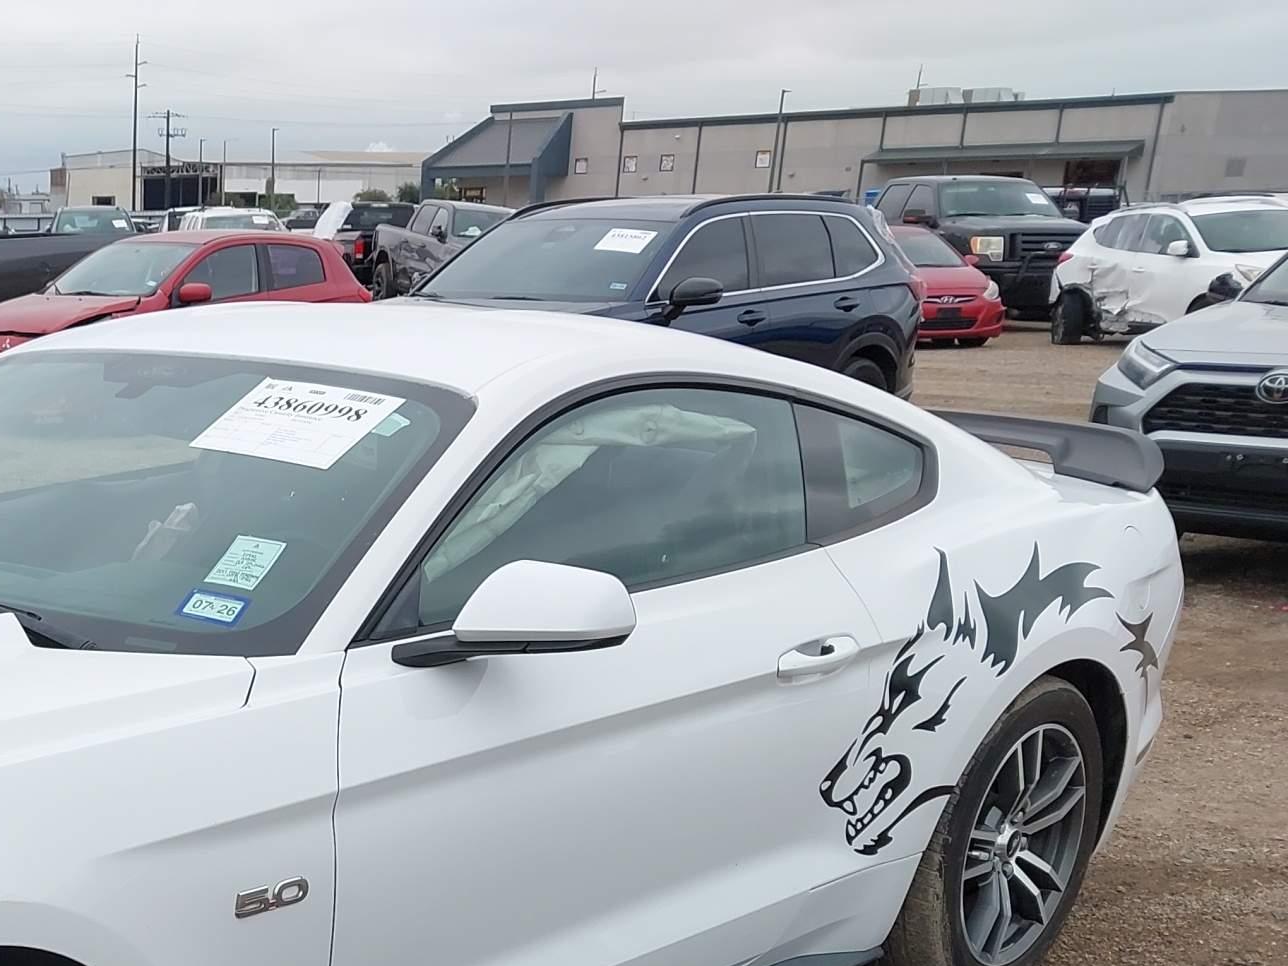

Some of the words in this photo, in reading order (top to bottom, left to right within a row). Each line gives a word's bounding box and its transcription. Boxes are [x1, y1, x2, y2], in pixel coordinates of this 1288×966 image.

[253, 395, 368, 422] 43860998
[192, 599, 213, 610] 07
[217, 604, 238, 616] 26
[234, 876, 309, 919] 5.0
